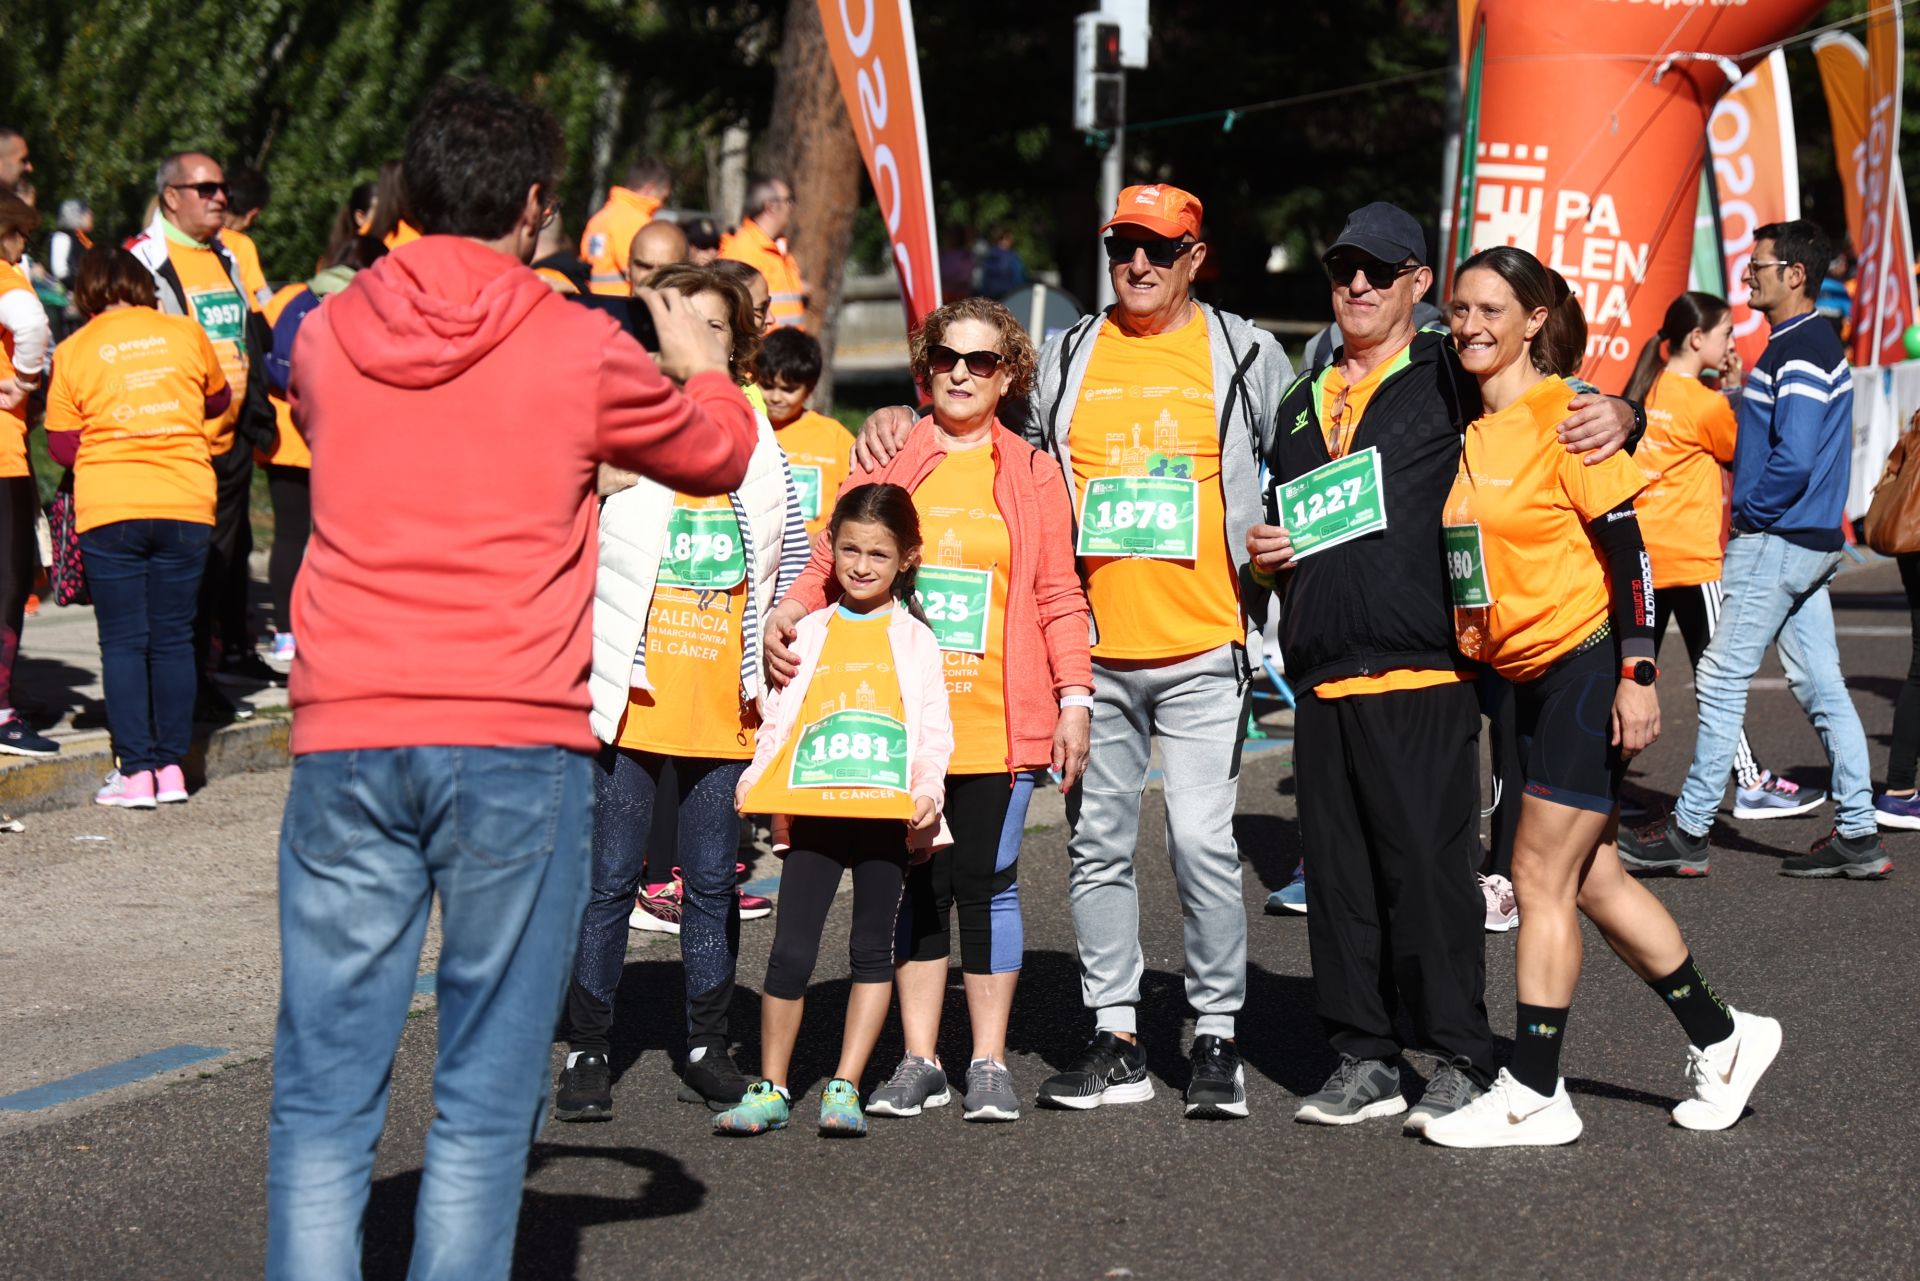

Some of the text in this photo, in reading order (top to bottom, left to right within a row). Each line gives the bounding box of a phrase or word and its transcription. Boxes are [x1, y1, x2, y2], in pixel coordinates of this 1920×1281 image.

[1554, 189, 1621, 236] PA
[1550, 235, 1650, 285] LEN
[202, 304, 240, 326] 3957
[1097, 501, 1177, 530] 1878
[1293, 476, 1361, 528] 1227
[662, 532, 733, 562] 1879
[649, 607, 729, 633] PALENCIA
[914, 589, 968, 622] 25
[650, 639, 664, 652] EL
[659, 627, 697, 639] MARCHA
[811, 733, 890, 763] 1881
[822, 791, 836, 800] EL
